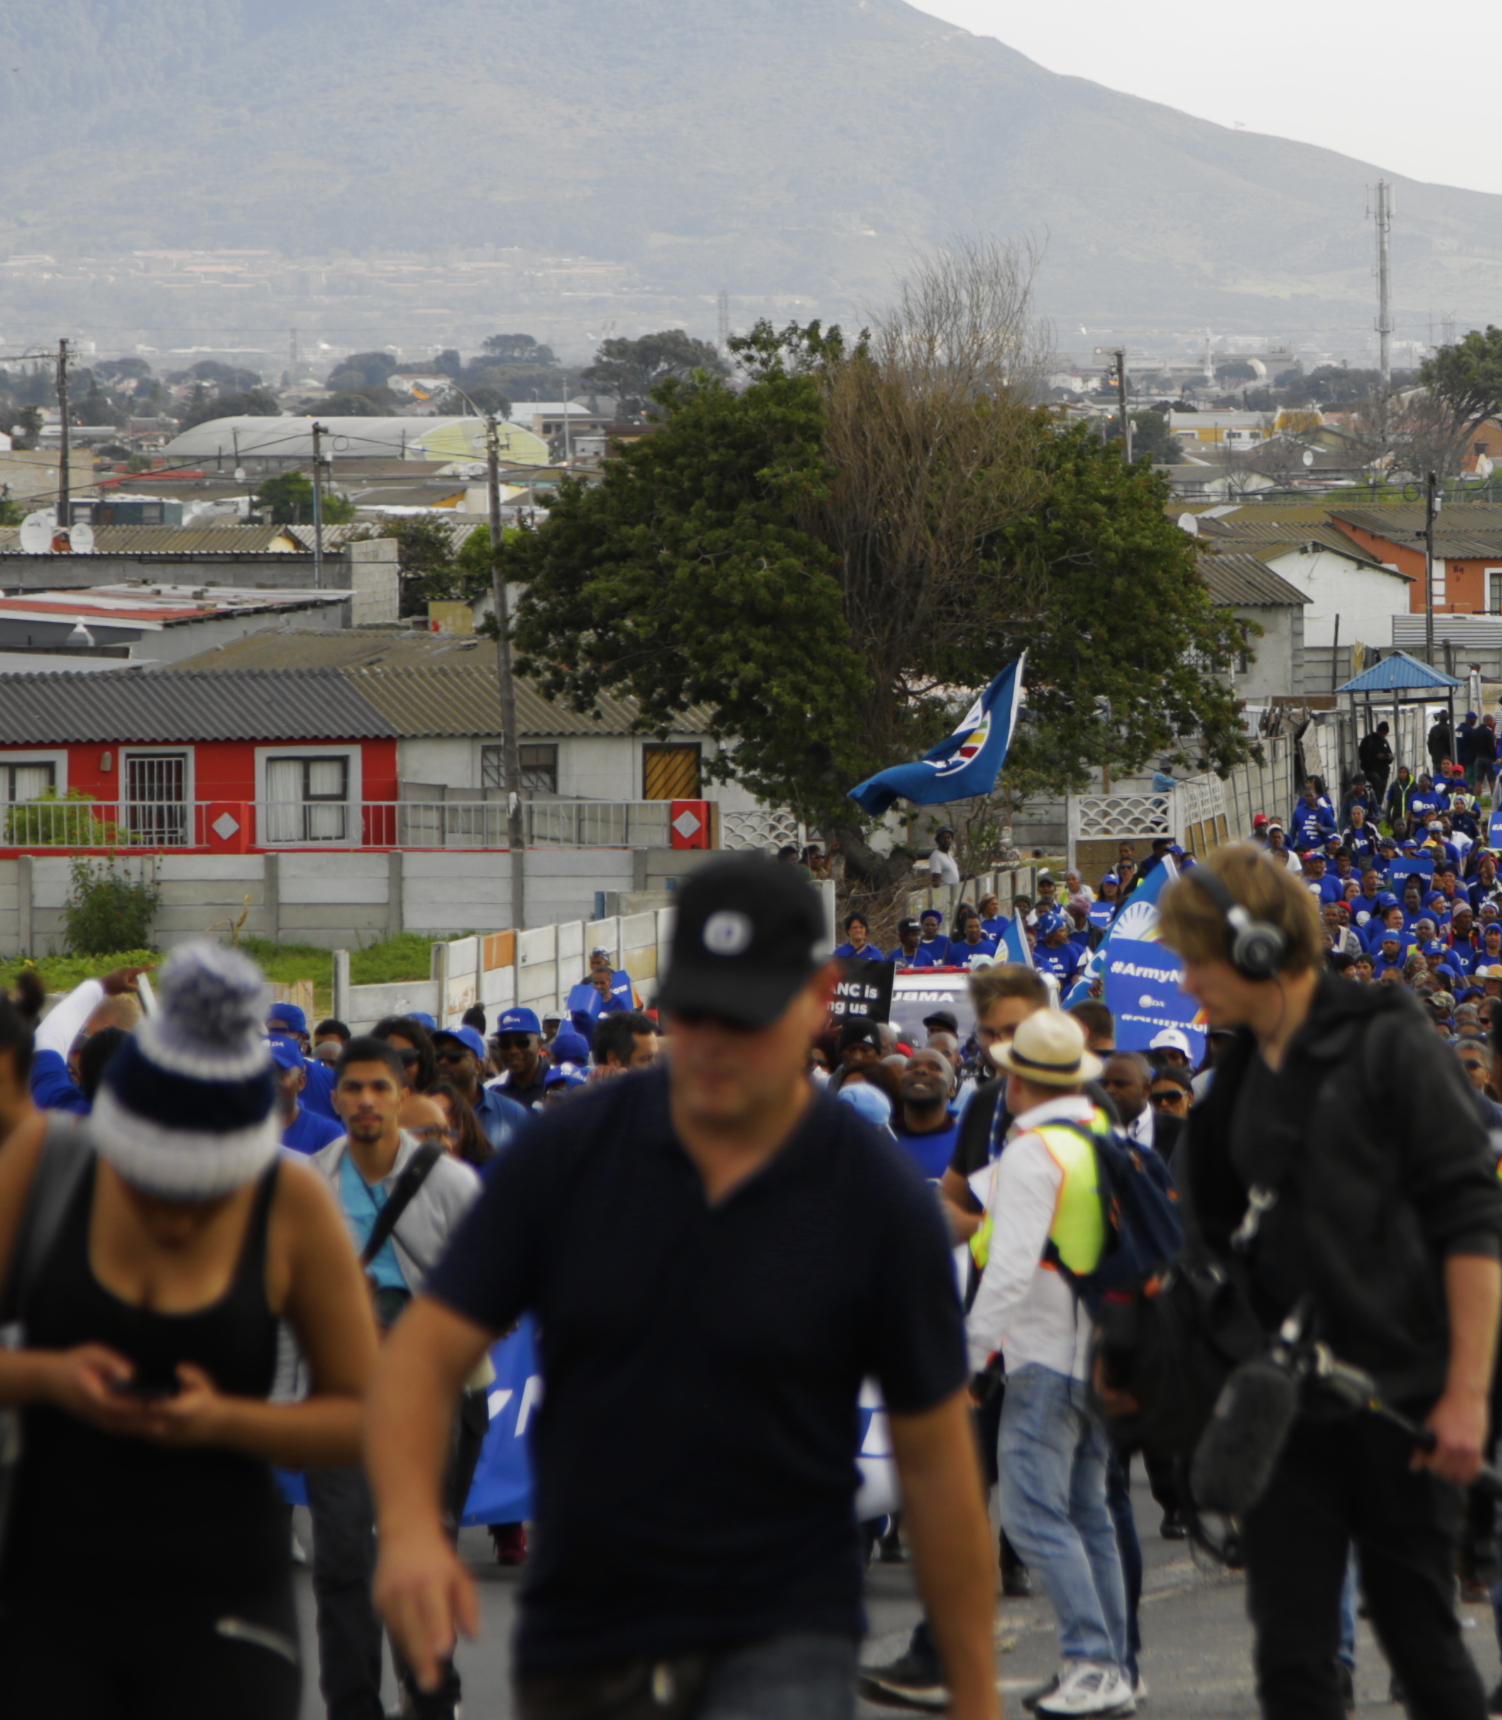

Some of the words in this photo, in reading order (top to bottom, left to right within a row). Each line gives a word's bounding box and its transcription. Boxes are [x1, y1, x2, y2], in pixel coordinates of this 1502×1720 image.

[1110, 961, 1186, 983] #ArmyN
[864, 985, 878, 1000] is
[848, 1003, 868, 1015] us
